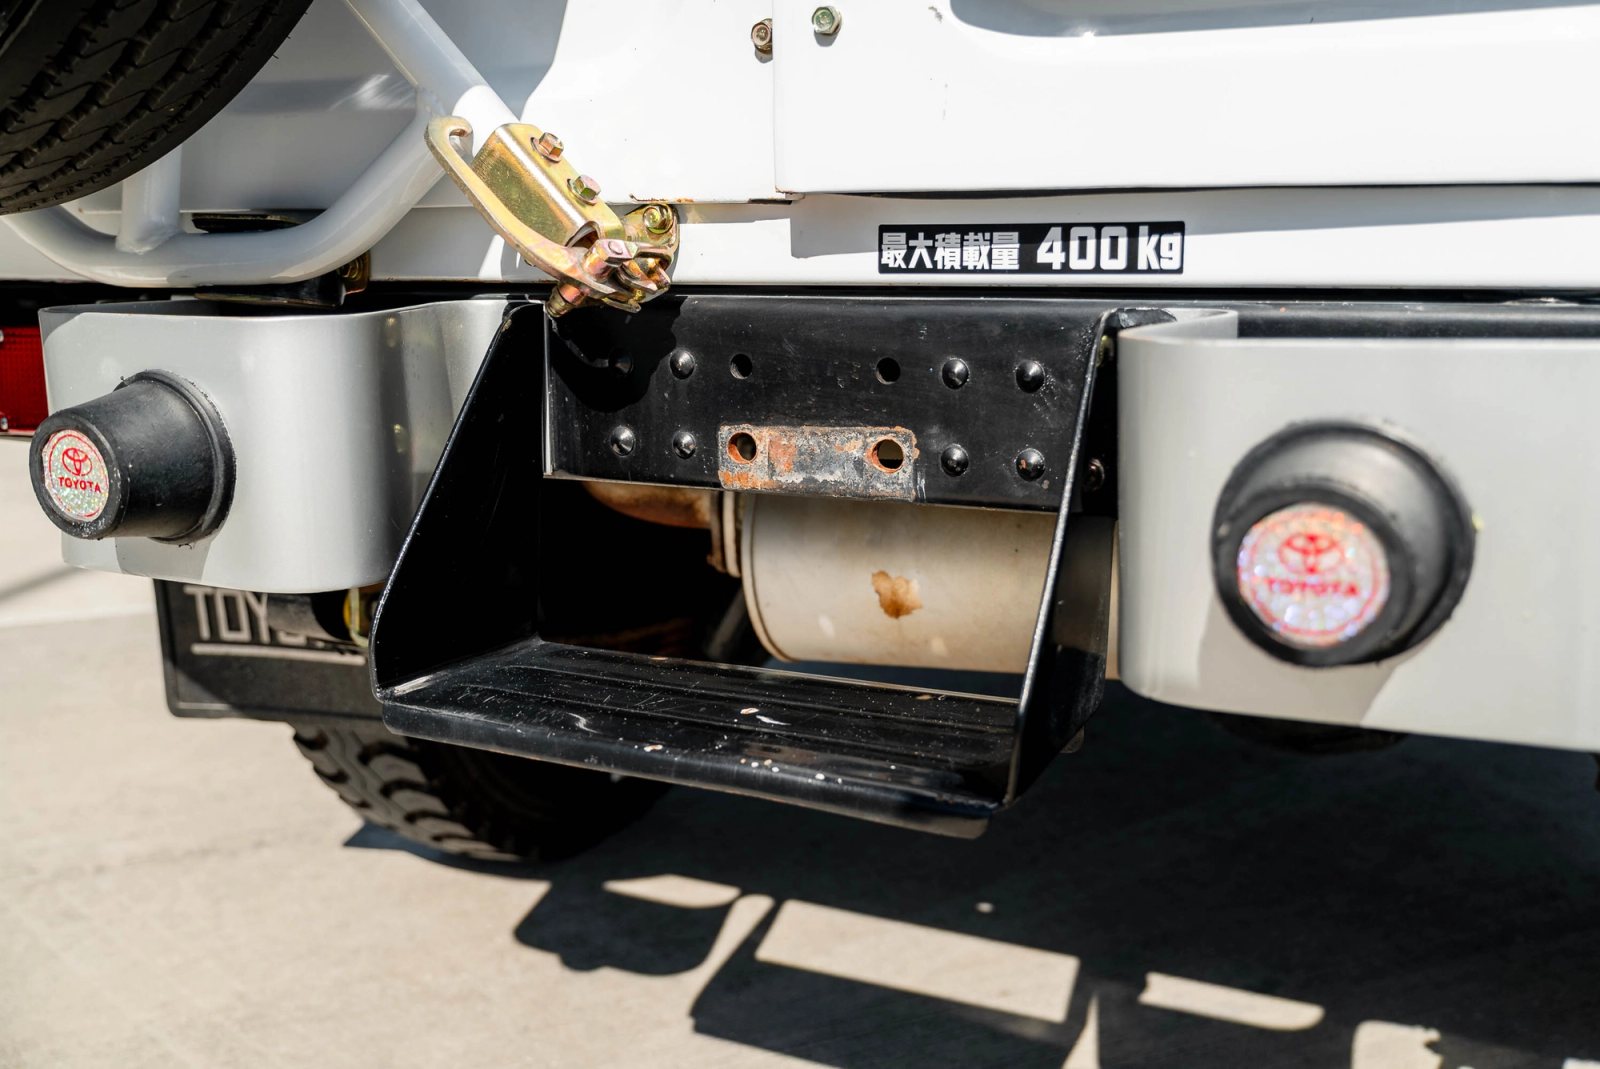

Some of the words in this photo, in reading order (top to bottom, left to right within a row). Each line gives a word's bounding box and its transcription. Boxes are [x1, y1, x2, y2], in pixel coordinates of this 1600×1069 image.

[881, 232, 1020, 270] 最大積載量
[1036, 226, 1128, 271] 400
[1137, 225, 1182, 271] kg
[58, 476, 102, 493] TOYOTA
